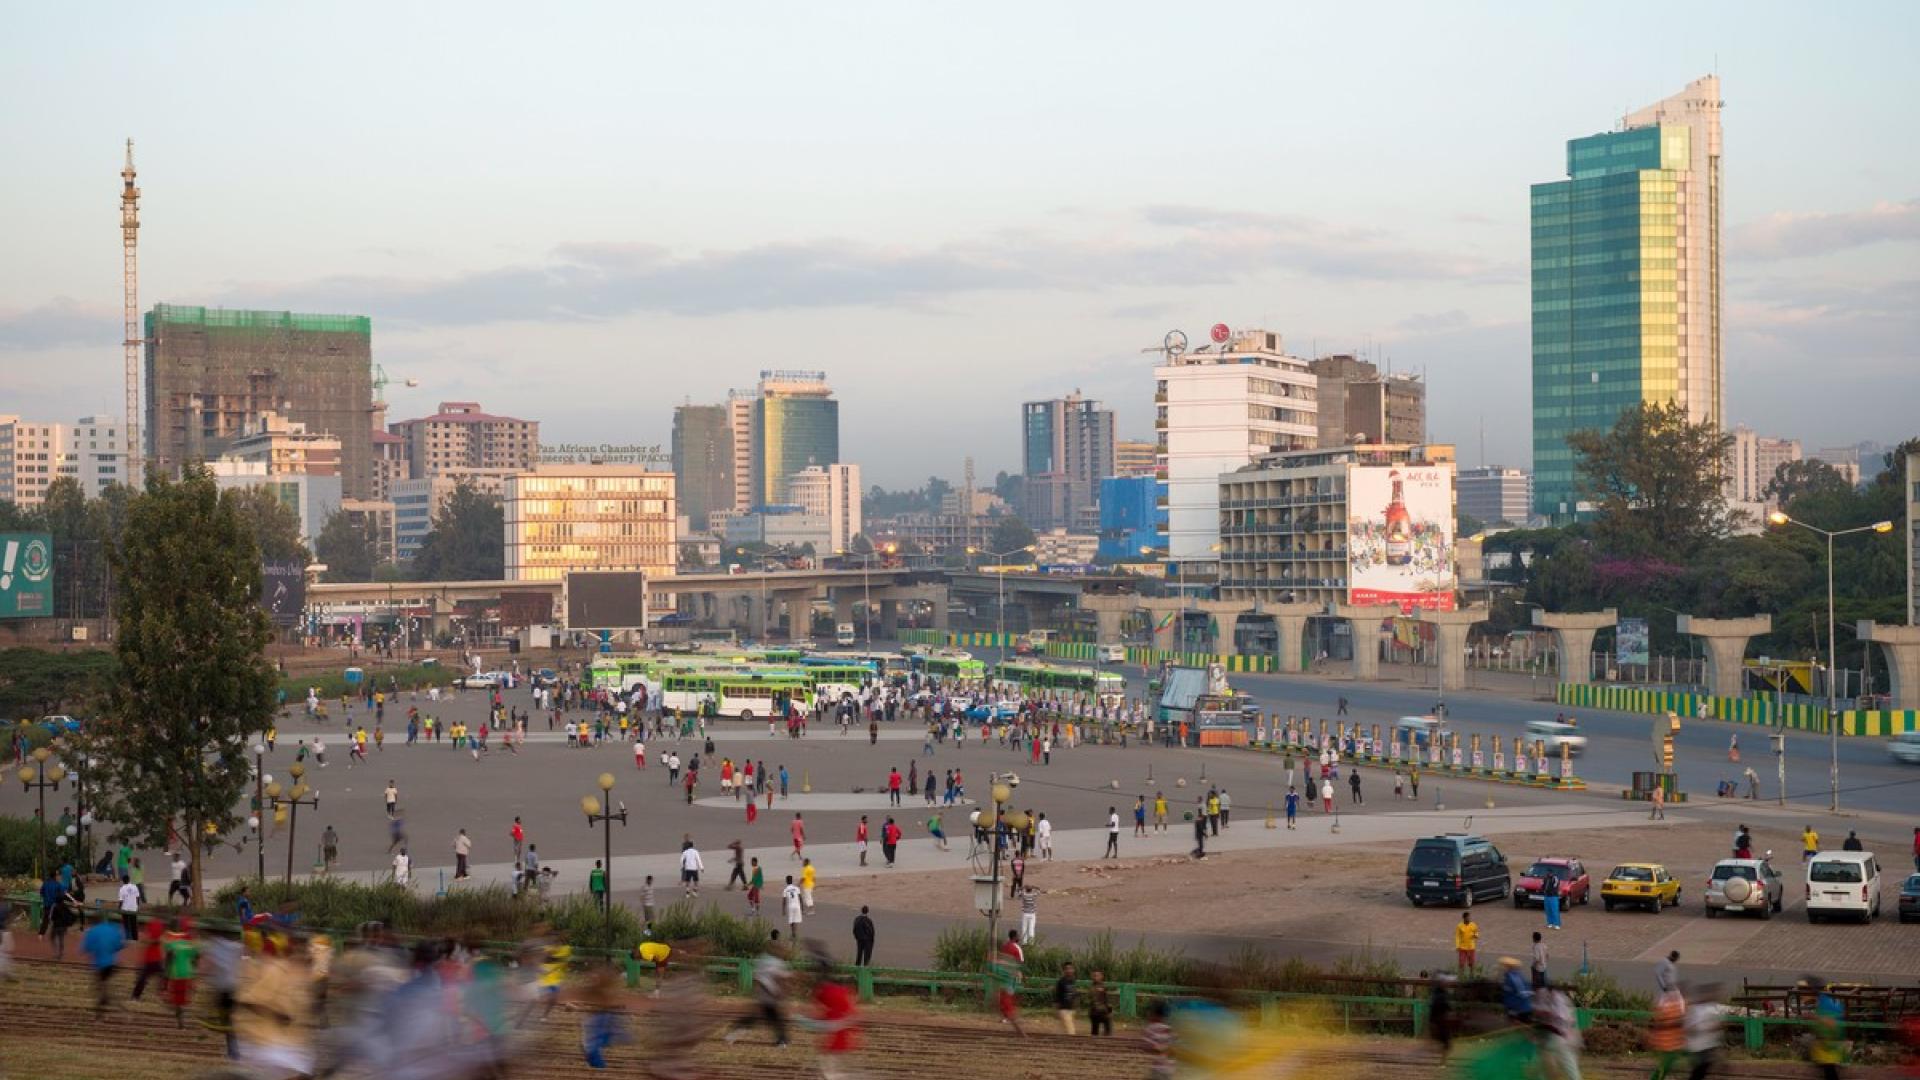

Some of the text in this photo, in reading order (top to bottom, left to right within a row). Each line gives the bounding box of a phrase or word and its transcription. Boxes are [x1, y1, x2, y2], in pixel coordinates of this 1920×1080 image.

[536, 443, 662, 453] Pan African Chamber of
[577, 453, 587, 462] &
[590, 453, 635, 464] Industry
